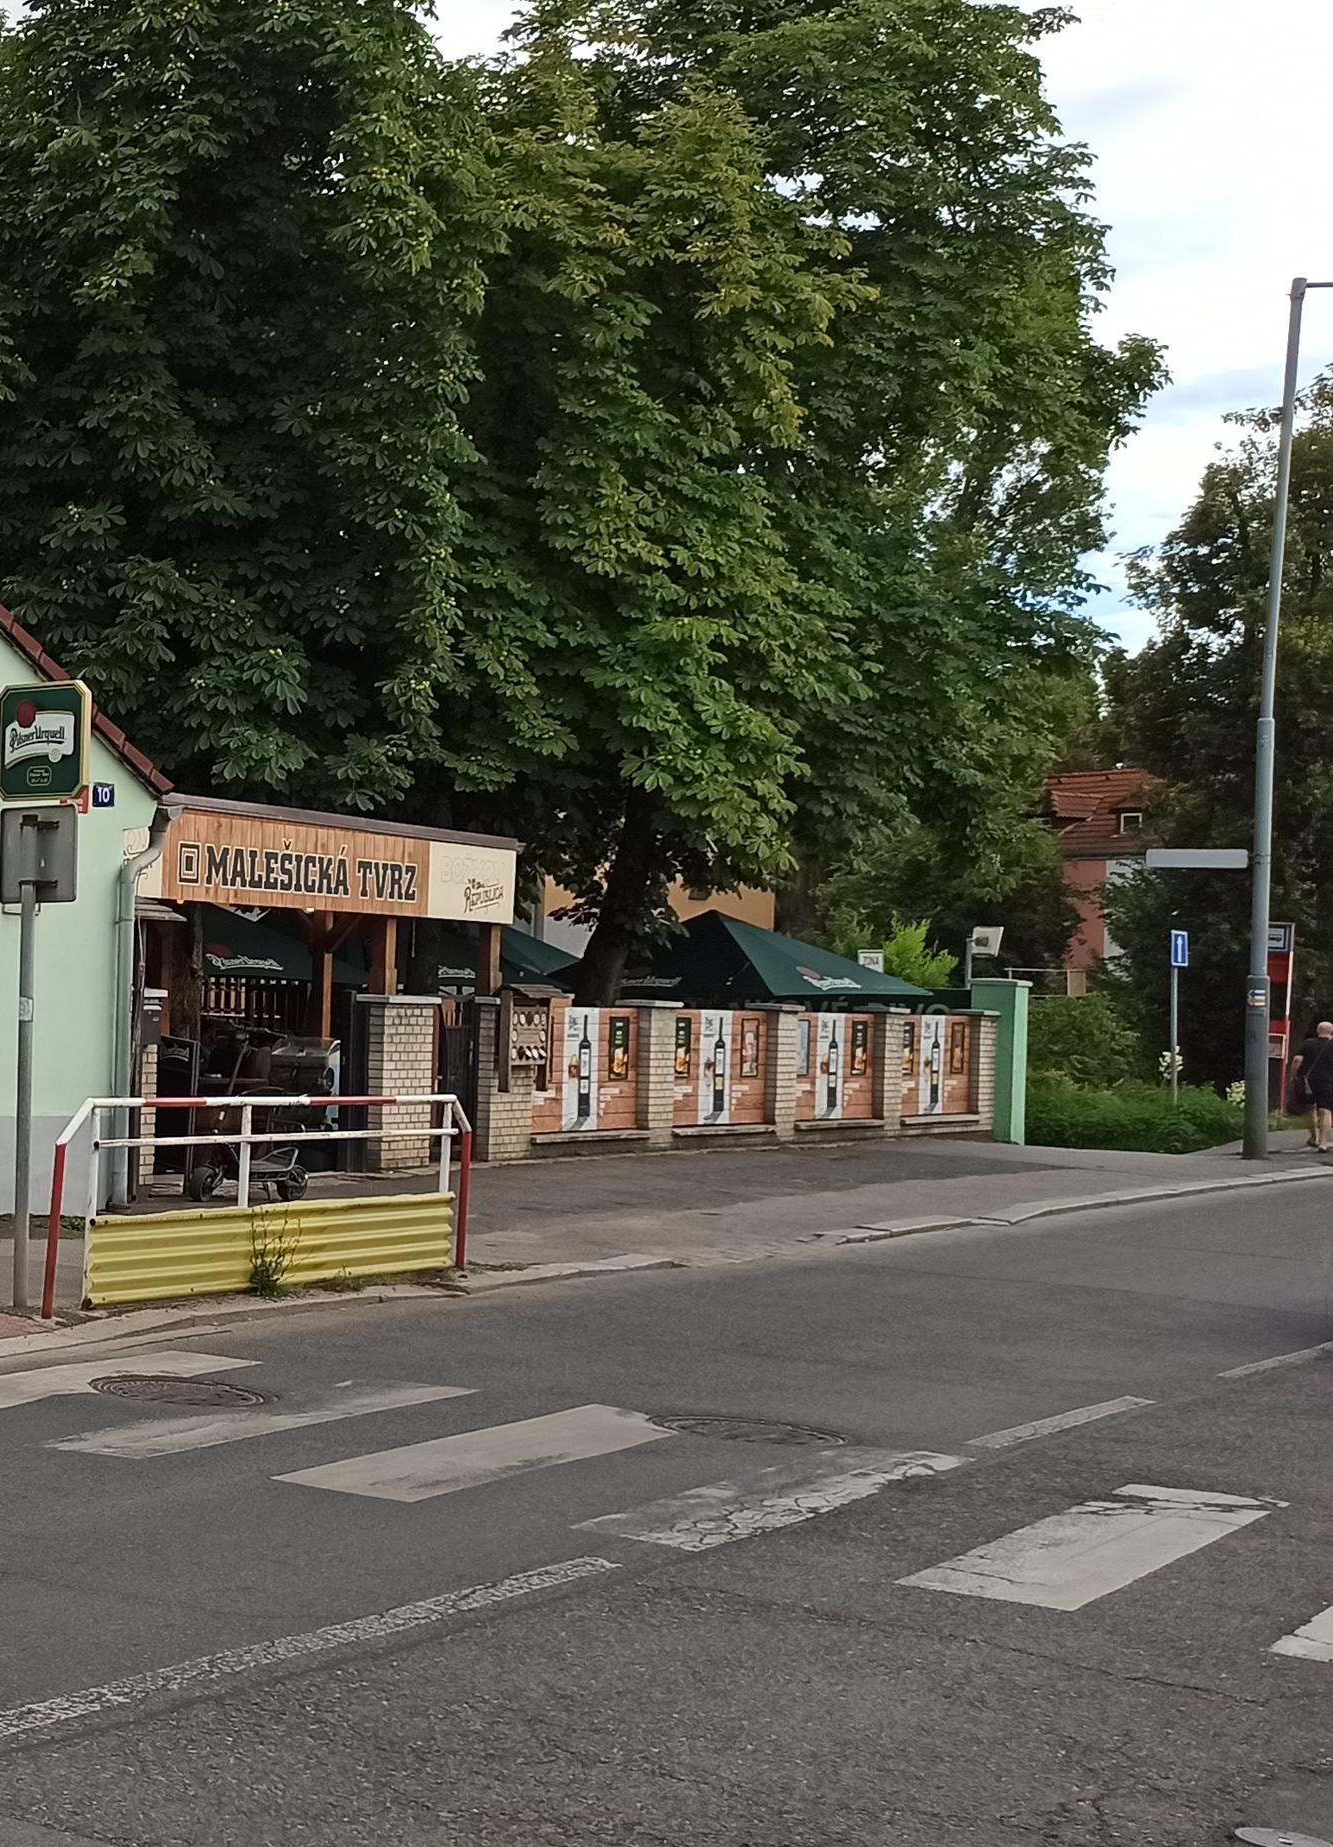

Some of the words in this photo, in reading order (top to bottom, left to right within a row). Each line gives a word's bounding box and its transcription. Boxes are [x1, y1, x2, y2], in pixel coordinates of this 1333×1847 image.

[34, 725, 65, 747] Urquell
[97, 786, 111, 803] 10
[205, 838, 350, 897] MALEŠICKÁ
[356, 858, 418, 902] TVRZ
